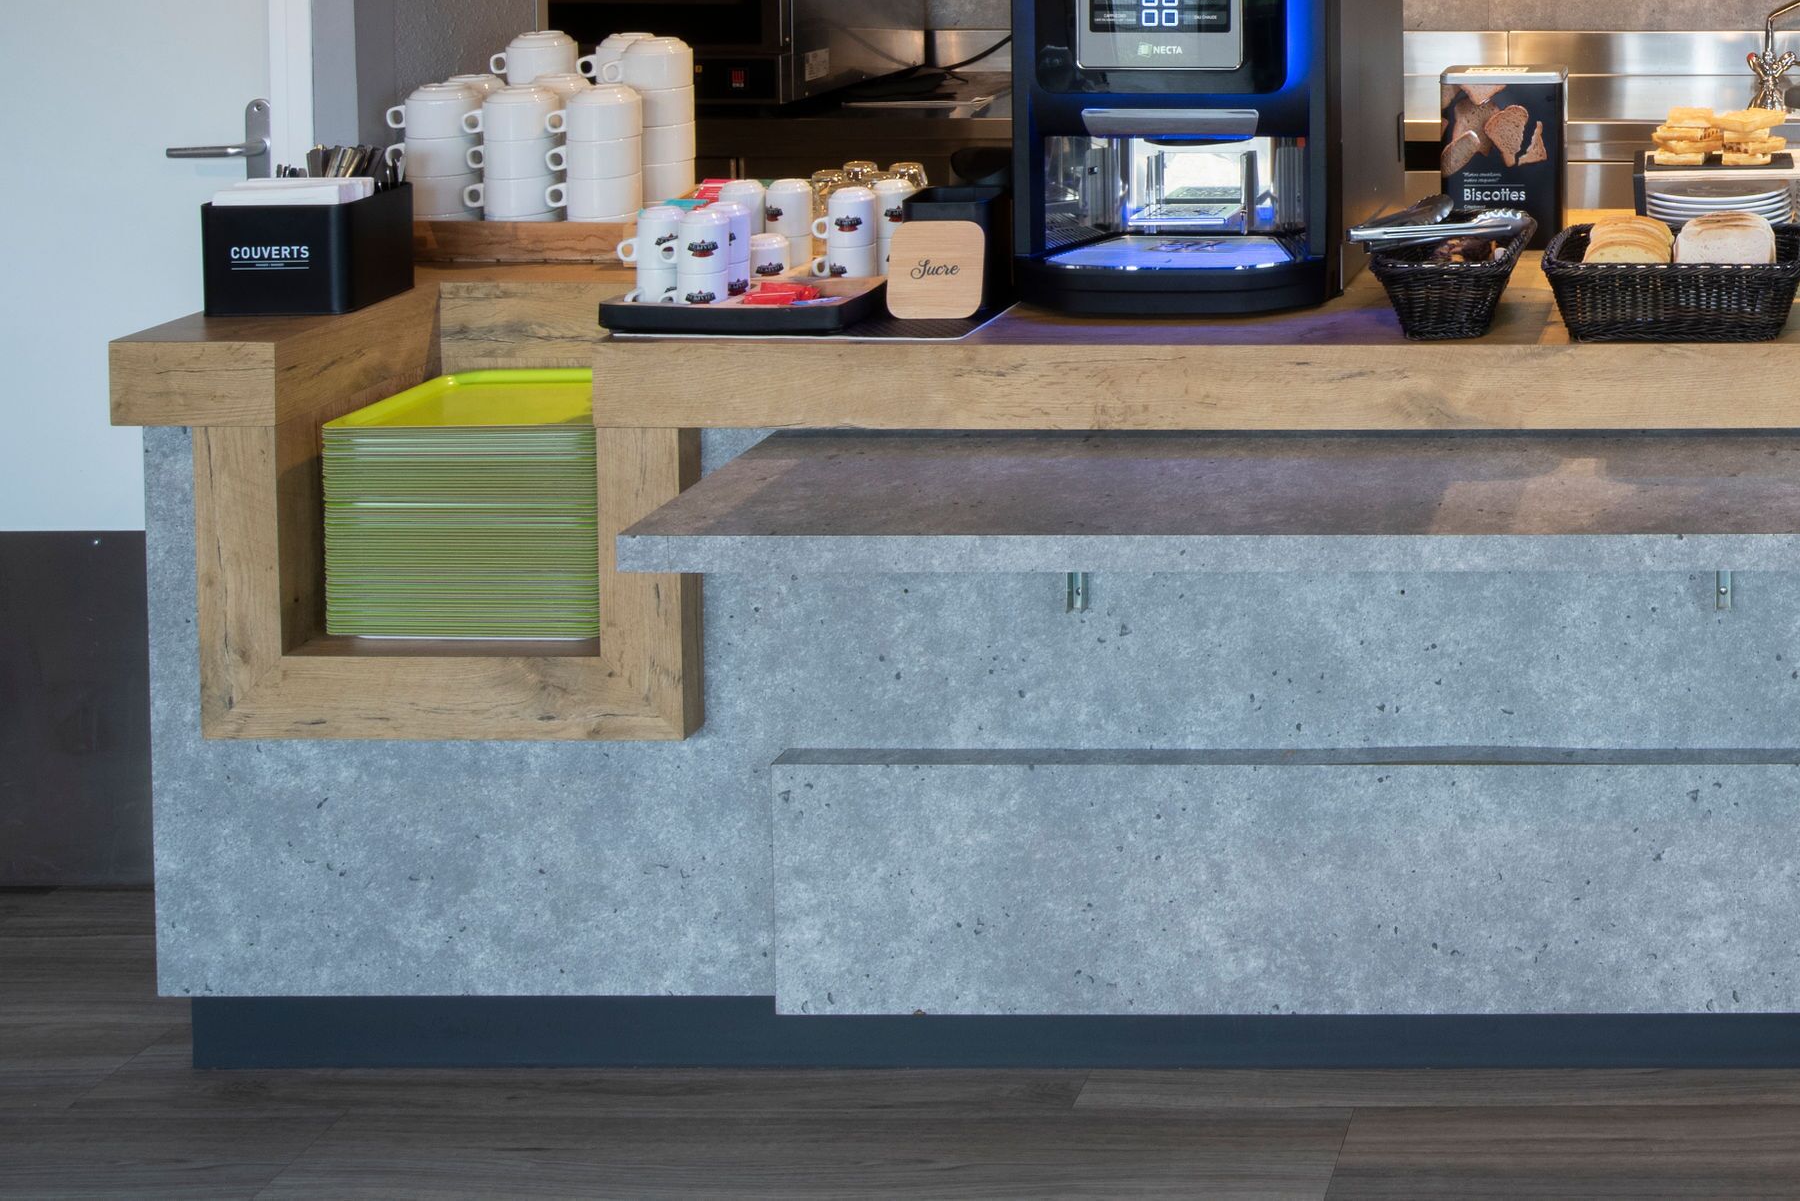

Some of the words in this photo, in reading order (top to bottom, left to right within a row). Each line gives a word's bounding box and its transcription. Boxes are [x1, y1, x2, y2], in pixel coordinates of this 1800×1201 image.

[1153, 45, 1183, 54] NECTA
[1463, 187, 1526, 201] Biscottes
[230, 246, 310, 259] COUVERTS
[910, 258, 960, 280] Sucre
